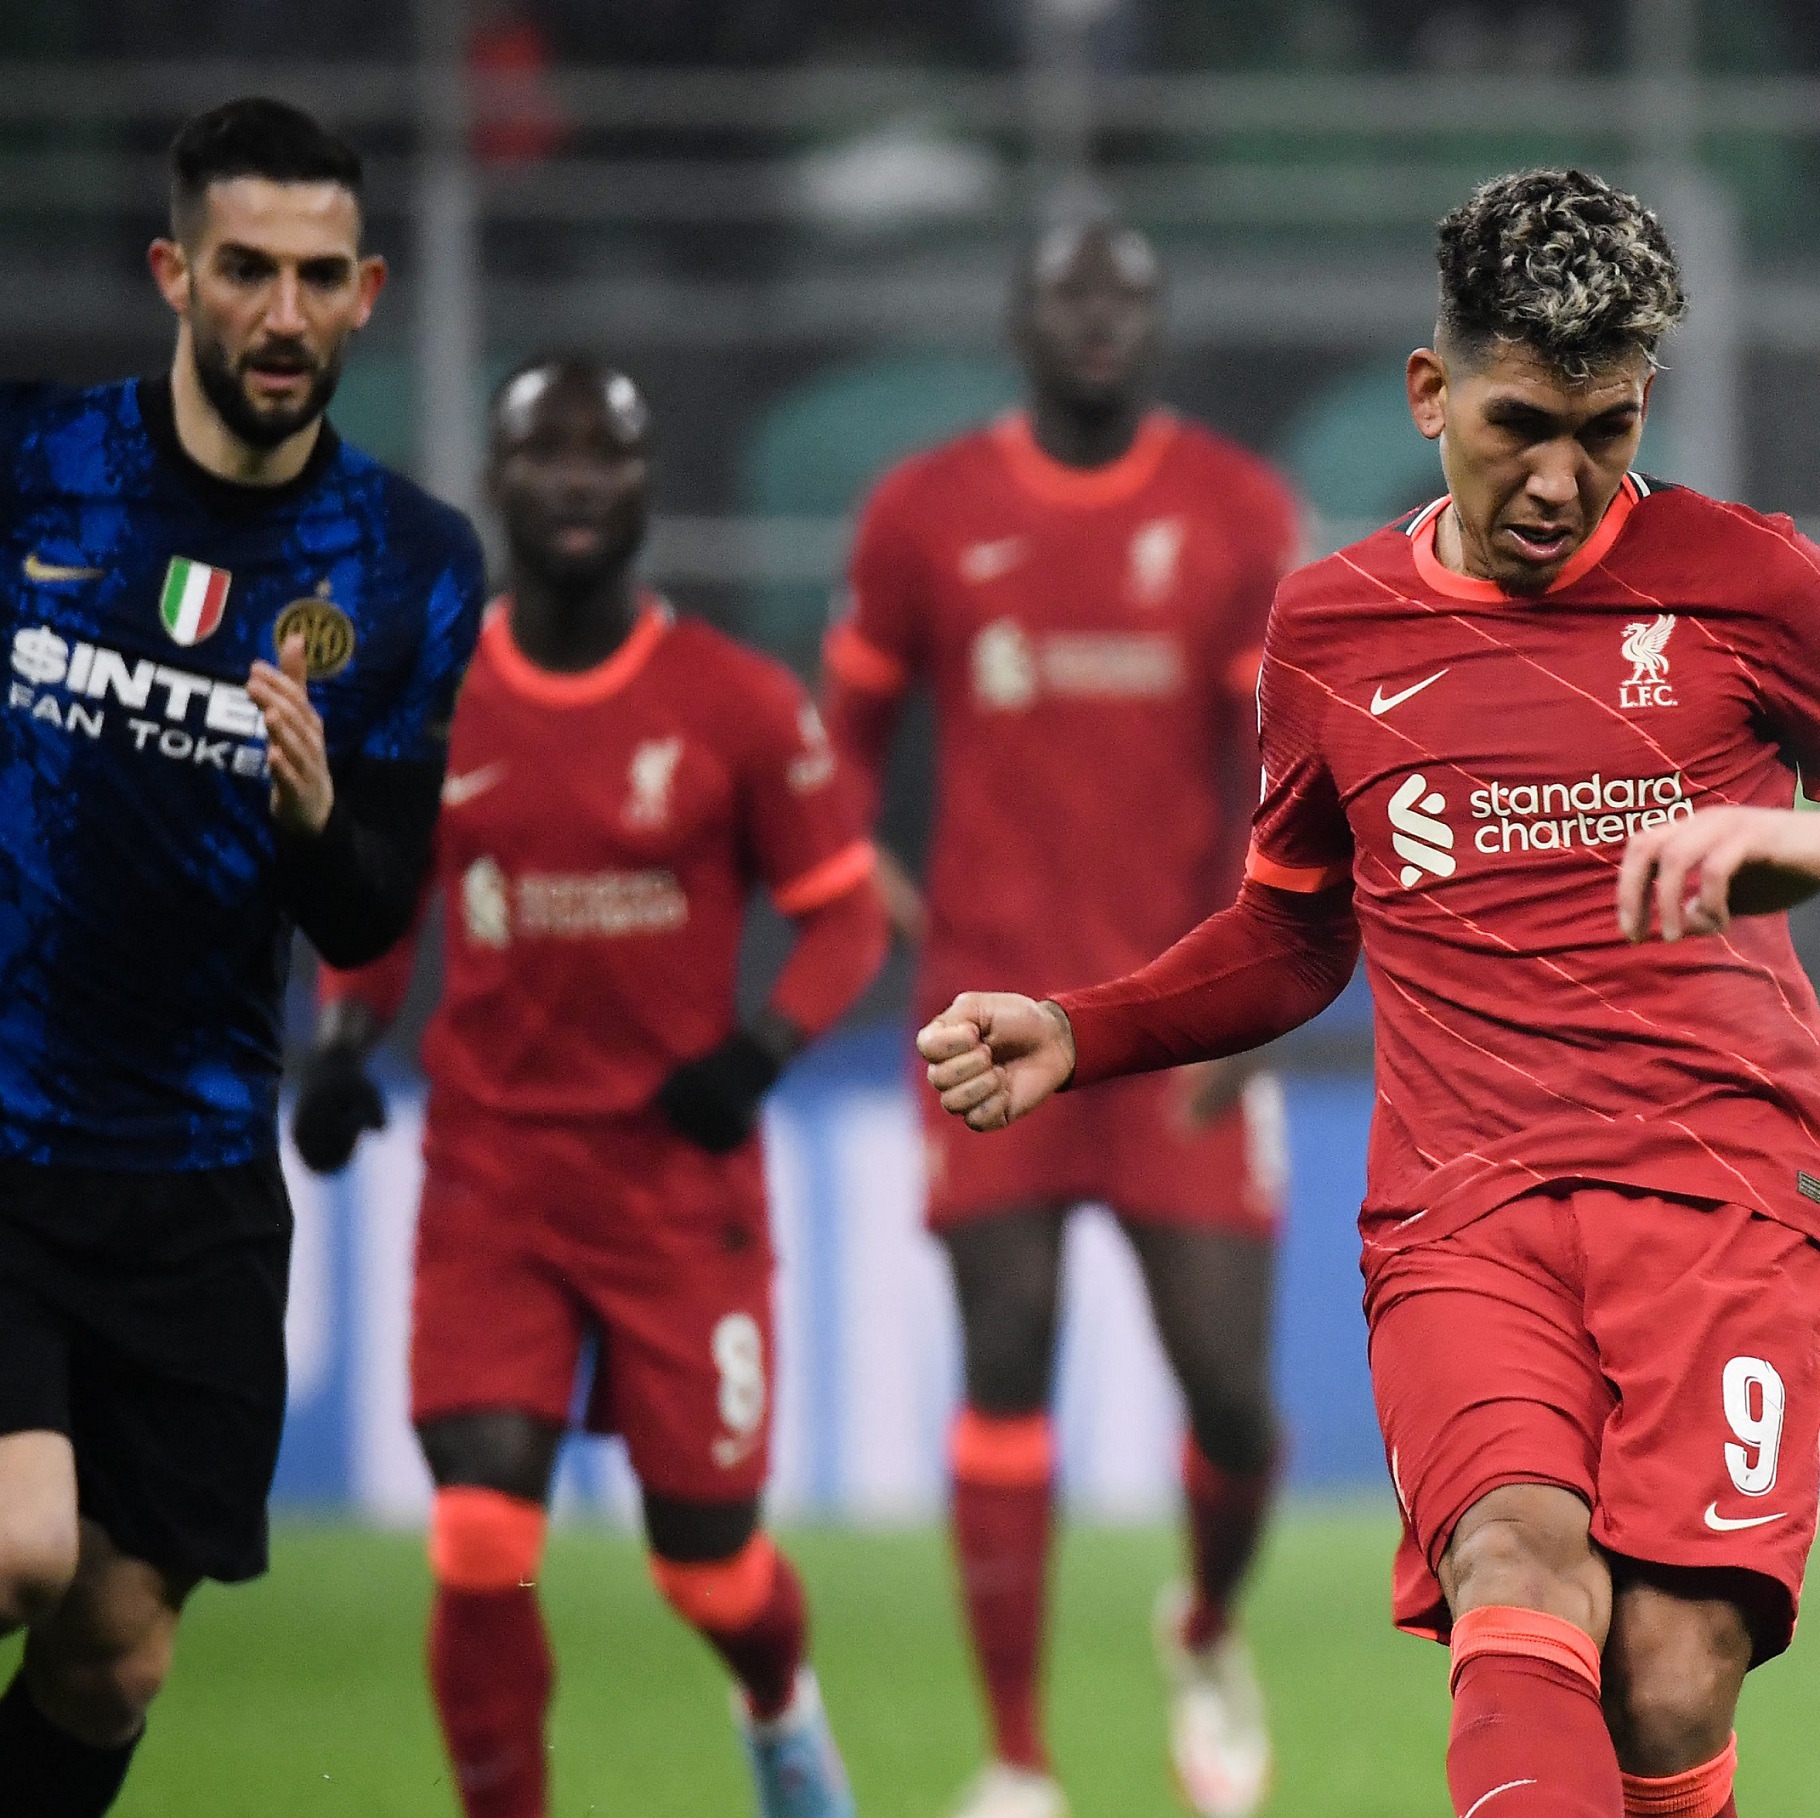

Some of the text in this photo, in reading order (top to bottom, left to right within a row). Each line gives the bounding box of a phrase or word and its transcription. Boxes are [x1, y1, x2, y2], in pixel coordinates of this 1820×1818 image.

[9, 680, 270, 780] FAN TOKE
[10, 625, 267, 738] $INTE
[1470, 772, 1683, 818] standard
[1722, 1356, 1786, 1497] 9
